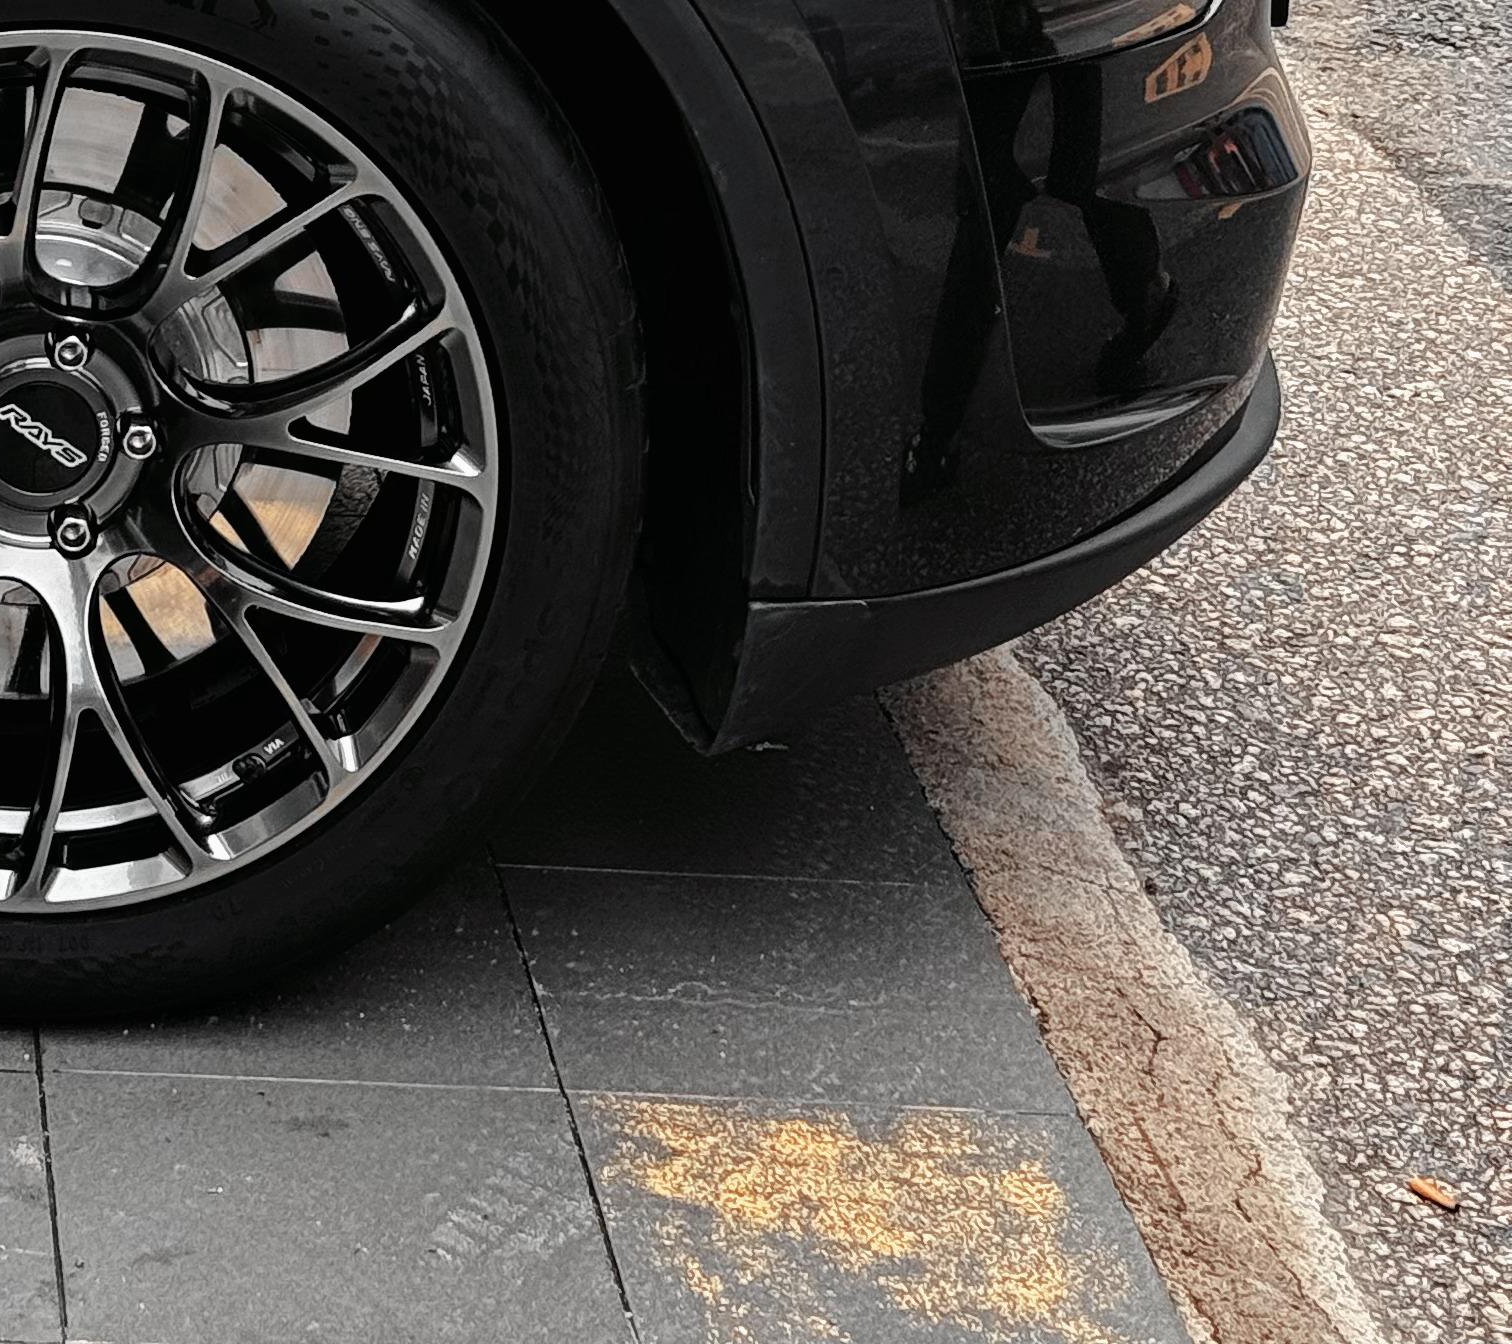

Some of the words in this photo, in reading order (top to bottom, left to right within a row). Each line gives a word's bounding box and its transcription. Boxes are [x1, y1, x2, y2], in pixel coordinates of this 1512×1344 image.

[416, 354, 433, 406] JAPAN
[96, 411, 111, 462] FORGED
[408, 513, 426, 561] MADE
[419, 491, 431, 511] IN
